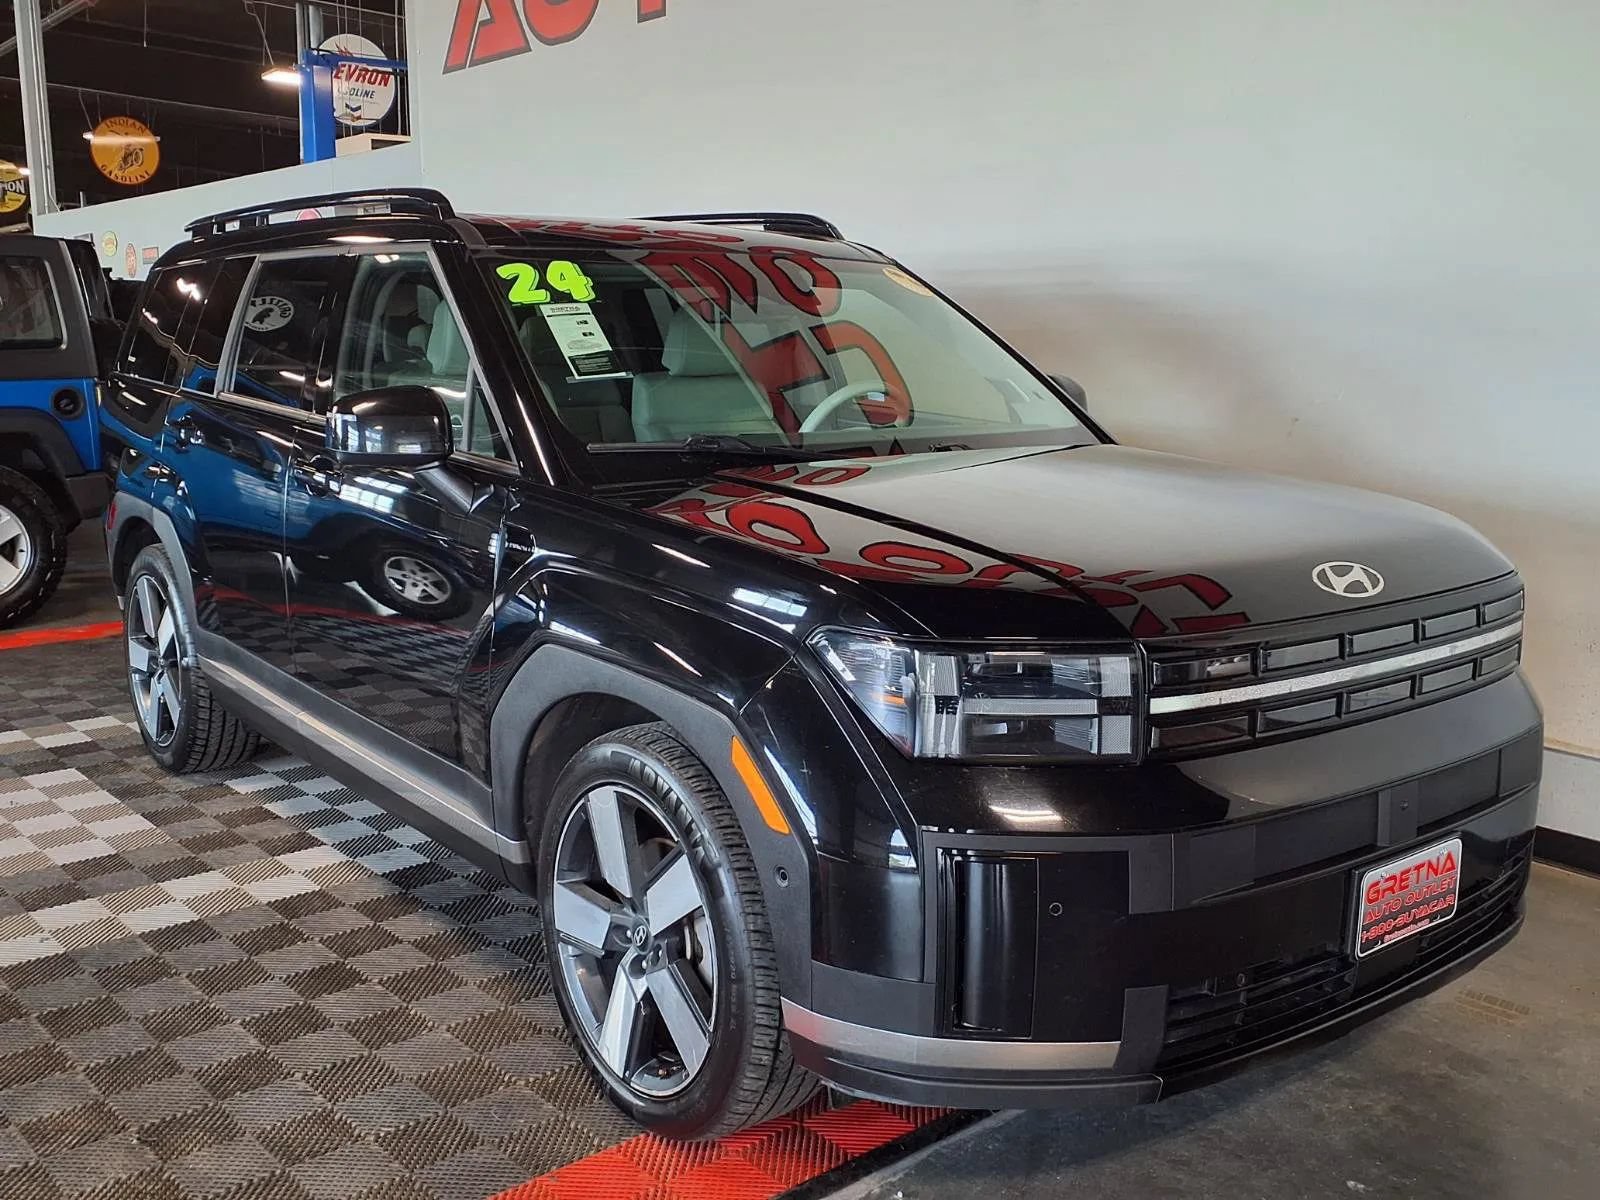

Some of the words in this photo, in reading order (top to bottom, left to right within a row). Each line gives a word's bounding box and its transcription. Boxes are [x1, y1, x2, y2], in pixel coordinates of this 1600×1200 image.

[496, 260, 596, 304] 24
[1363, 898, 1403, 924] AUTO
[1404, 876, 1457, 906] OUTLET
[1366, 850, 1457, 906] GRETNA
[1361, 893, 1456, 944] 1-800-BUYACAR
